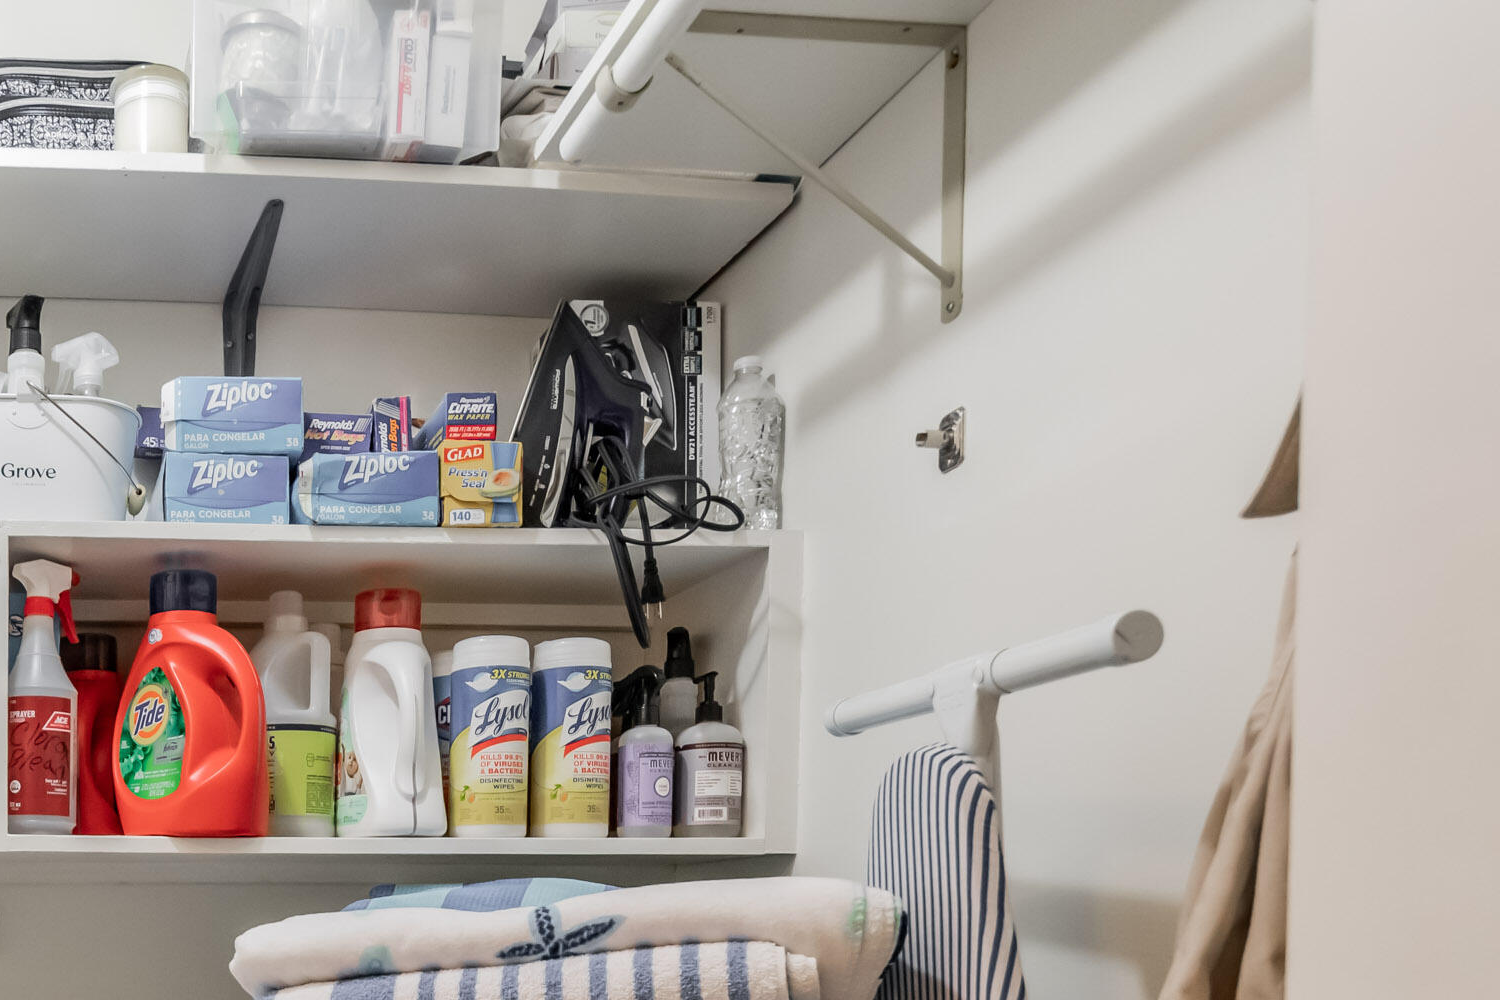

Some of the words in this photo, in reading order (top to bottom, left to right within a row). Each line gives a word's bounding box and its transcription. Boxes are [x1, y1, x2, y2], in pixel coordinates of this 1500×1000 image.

[206, 380, 273, 411] Ziploc
[448, 402, 494, 414] CUT-RITE
[310, 418, 354, 431] Reynolds
[389, 418, 400, 442] Bags
[184, 433, 209, 442] PARA
[212, 432, 266, 442] CONGELAR
[304, 429, 327, 440] Hot
[330, 431, 367, 445] Bags
[446, 447, 483, 461] GLAD
[688, 438, 696, 461] DW21
[1, 463, 57, 479] Grove
[192, 458, 258, 489] Ziploc
[343, 456, 410, 484] Ziploc
[448, 467, 488, 478] Press'n
[461, 479, 486, 488] Seal
[170, 511, 196, 519] PARA
[198, 510, 251, 519] CONGELAR
[319, 504, 345, 513] PARA
[348, 504, 402, 514] CONGELAR
[452, 511, 471, 521] 140
[490, 669, 506, 680] 3X
[584, 669, 599, 680] 3X
[54, 716, 69, 724] ACE
[134, 698, 165, 736] Tide
[474, 692, 528, 736] Lysol
[568, 697, 611, 737] Lyso
[488, 767, 524, 775] BACTERIA
